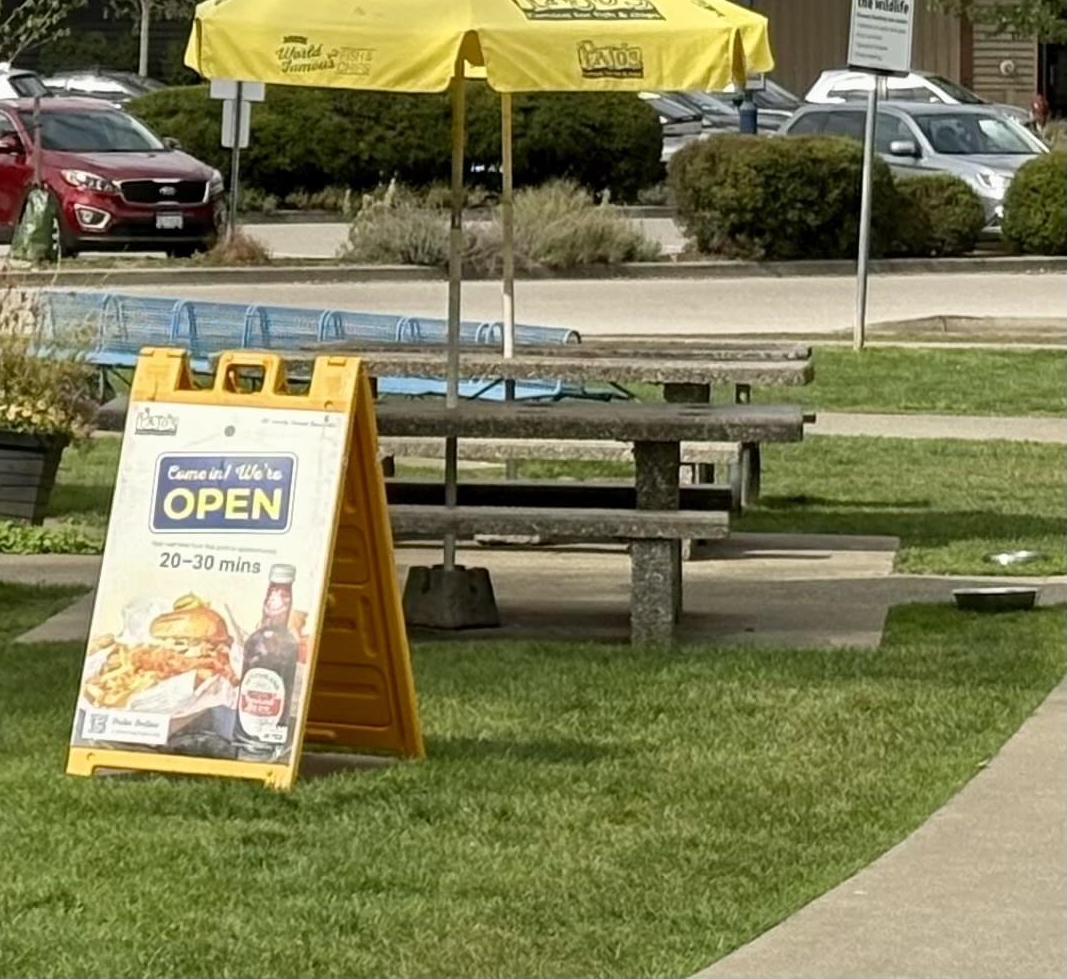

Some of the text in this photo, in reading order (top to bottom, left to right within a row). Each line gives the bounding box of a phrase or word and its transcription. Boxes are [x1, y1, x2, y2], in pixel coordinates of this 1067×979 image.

[275, 43, 323, 61] World
[281, 59, 335, 74] Famous
[167, 462, 283, 481] Come in! We're
[163, 487, 283, 520] OPEN
[219, 556, 261, 574] mins
